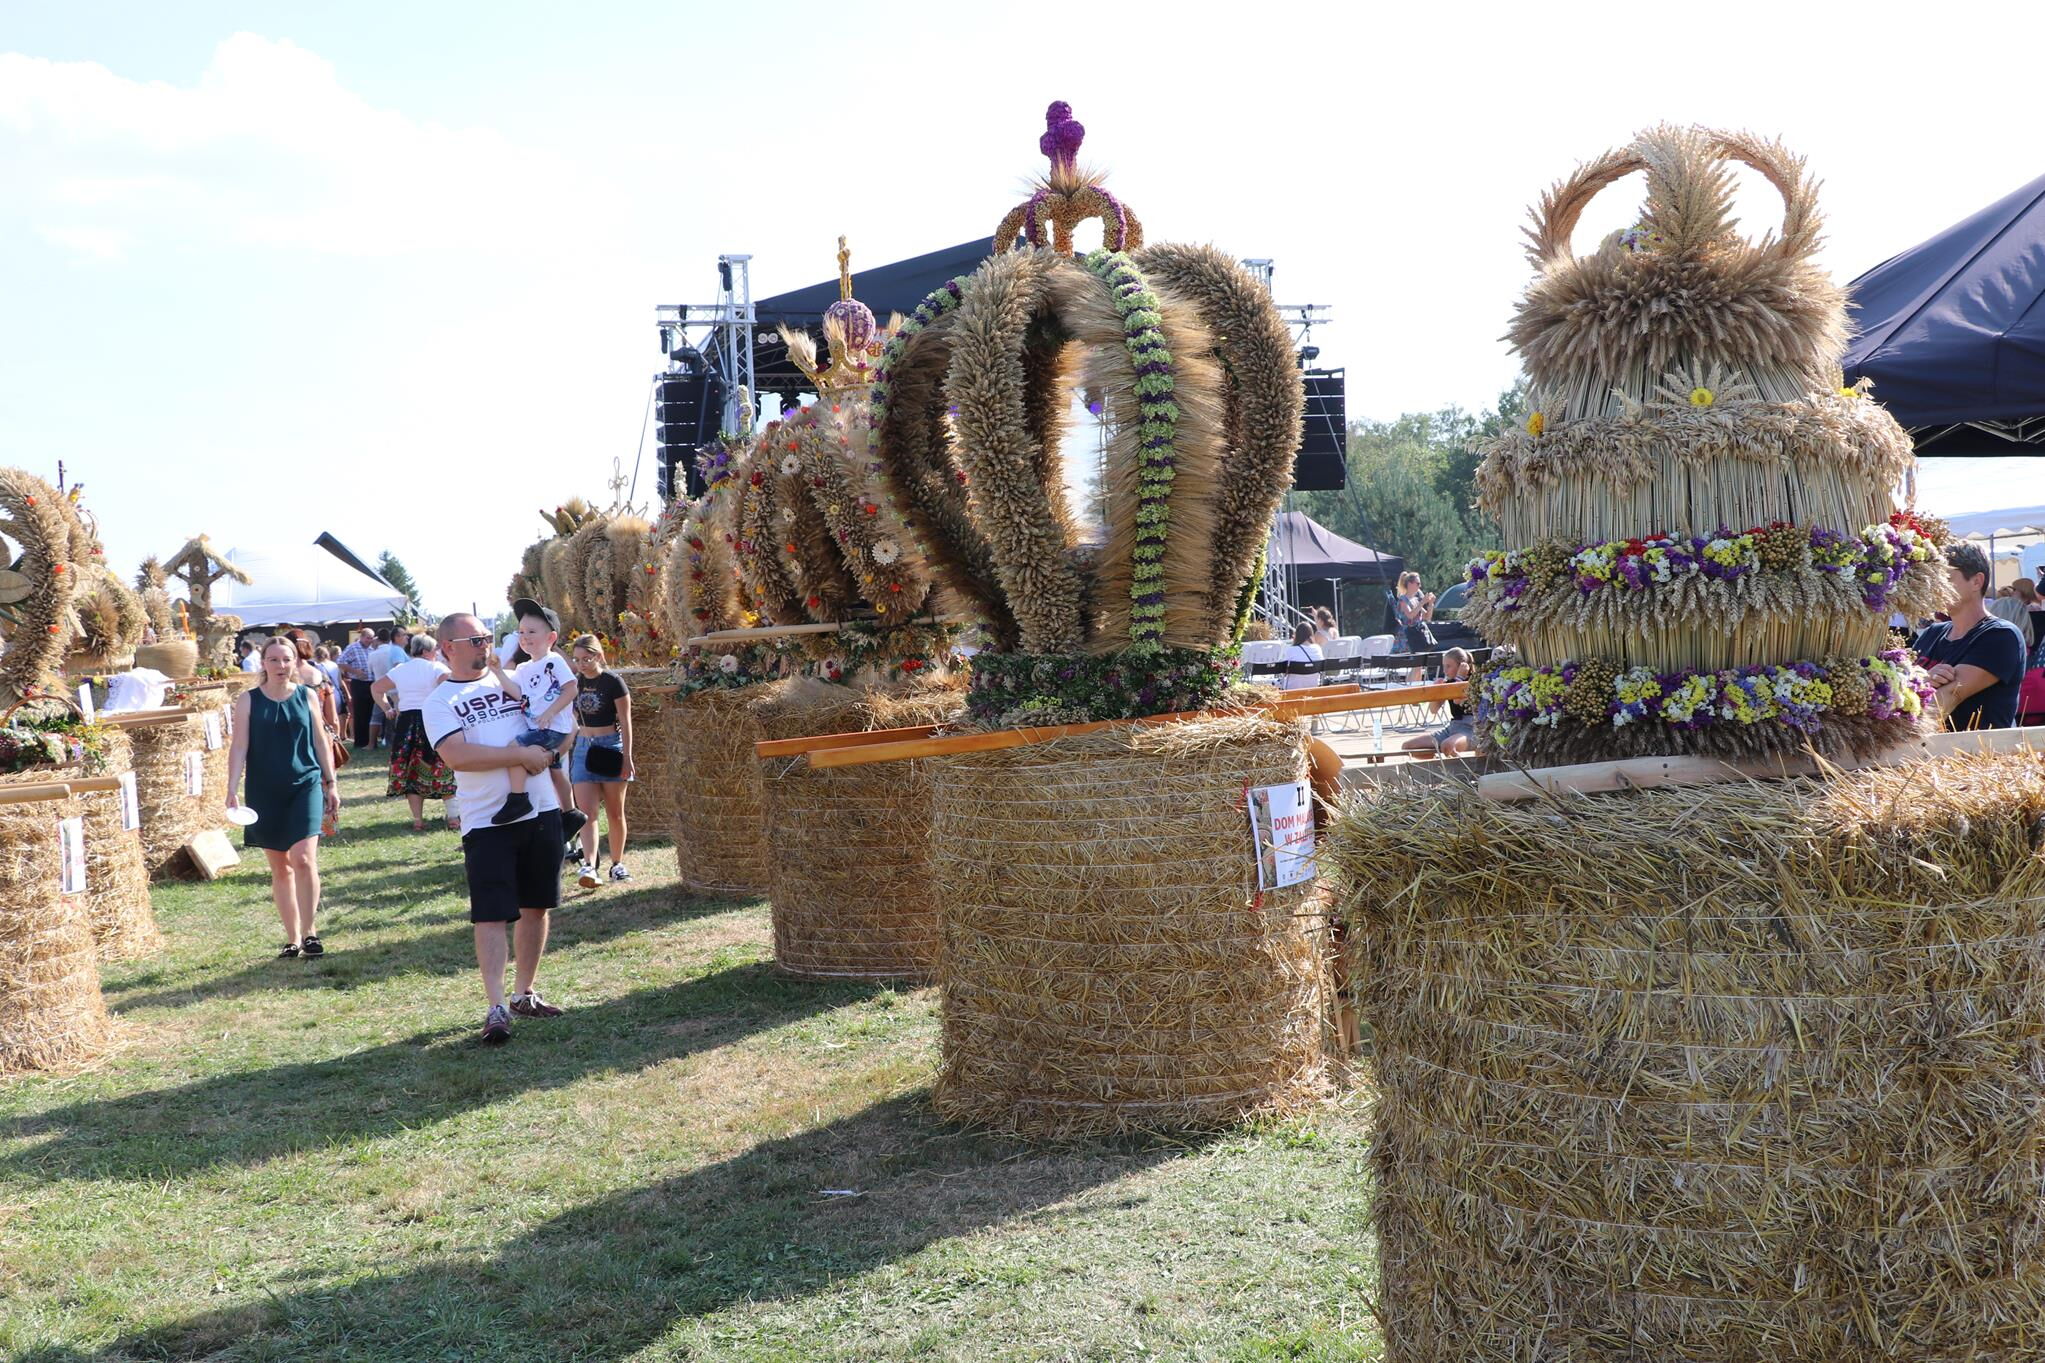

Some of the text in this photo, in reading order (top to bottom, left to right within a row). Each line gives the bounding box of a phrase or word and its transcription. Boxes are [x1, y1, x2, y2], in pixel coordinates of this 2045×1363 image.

[453, 690, 523, 718] USPA
[461, 708, 498, 727] 1890
[1274, 815, 1295, 831] DOM
[1284, 832, 1293, 846] W
